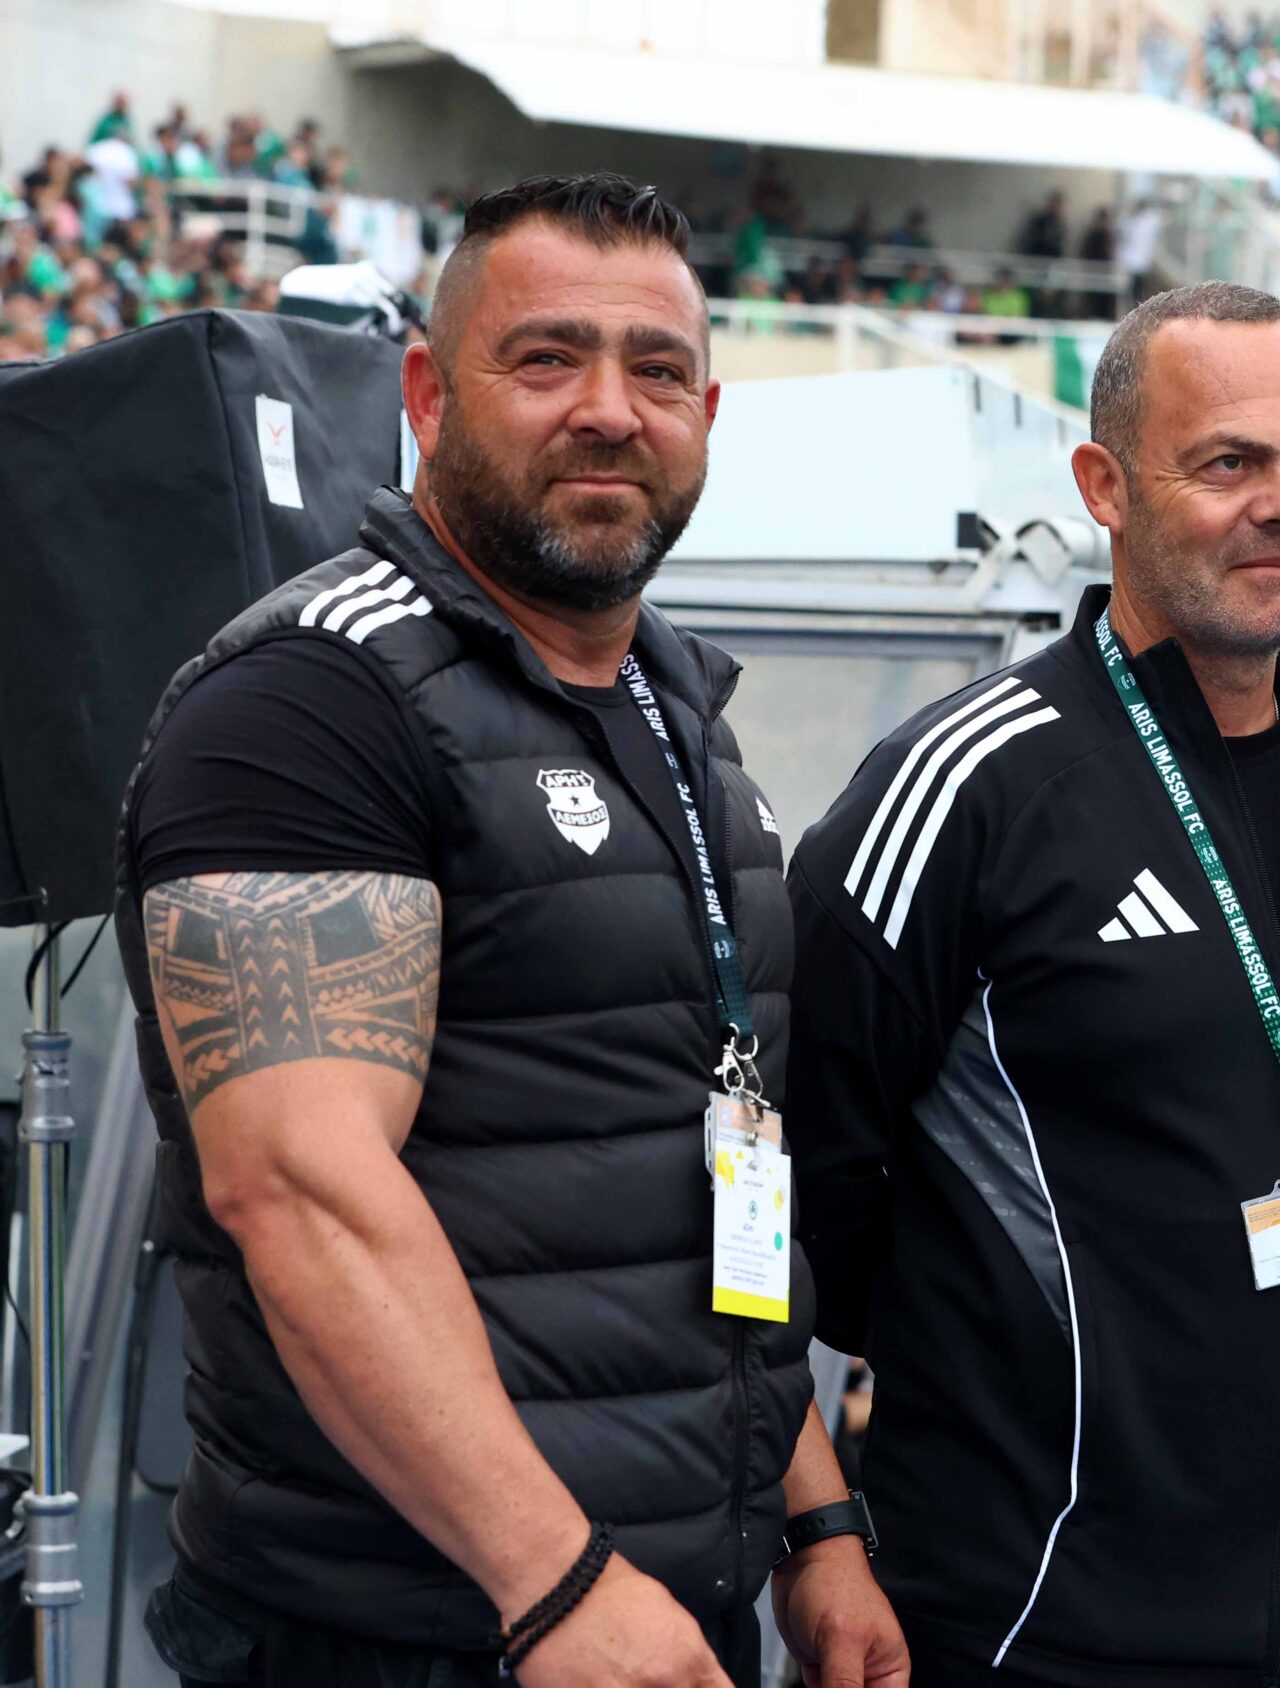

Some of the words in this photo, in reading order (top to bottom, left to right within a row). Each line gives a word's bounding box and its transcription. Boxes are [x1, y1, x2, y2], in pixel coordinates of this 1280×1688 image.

[1104, 645, 1123, 666] FC
[643, 707, 670, 741] ARIS
[1128, 702, 1158, 737] ARIS
[1146, 736, 1193, 812] LIMASSOL
[1183, 811, 1205, 834] FC
[677, 782, 694, 803] FC
[685, 807, 715, 886] LIMASSOL
[706, 887, 727, 926] ARIS
[1213, 879, 1240, 915] ARIS
[1230, 916, 1272, 995] LIMASSOL
